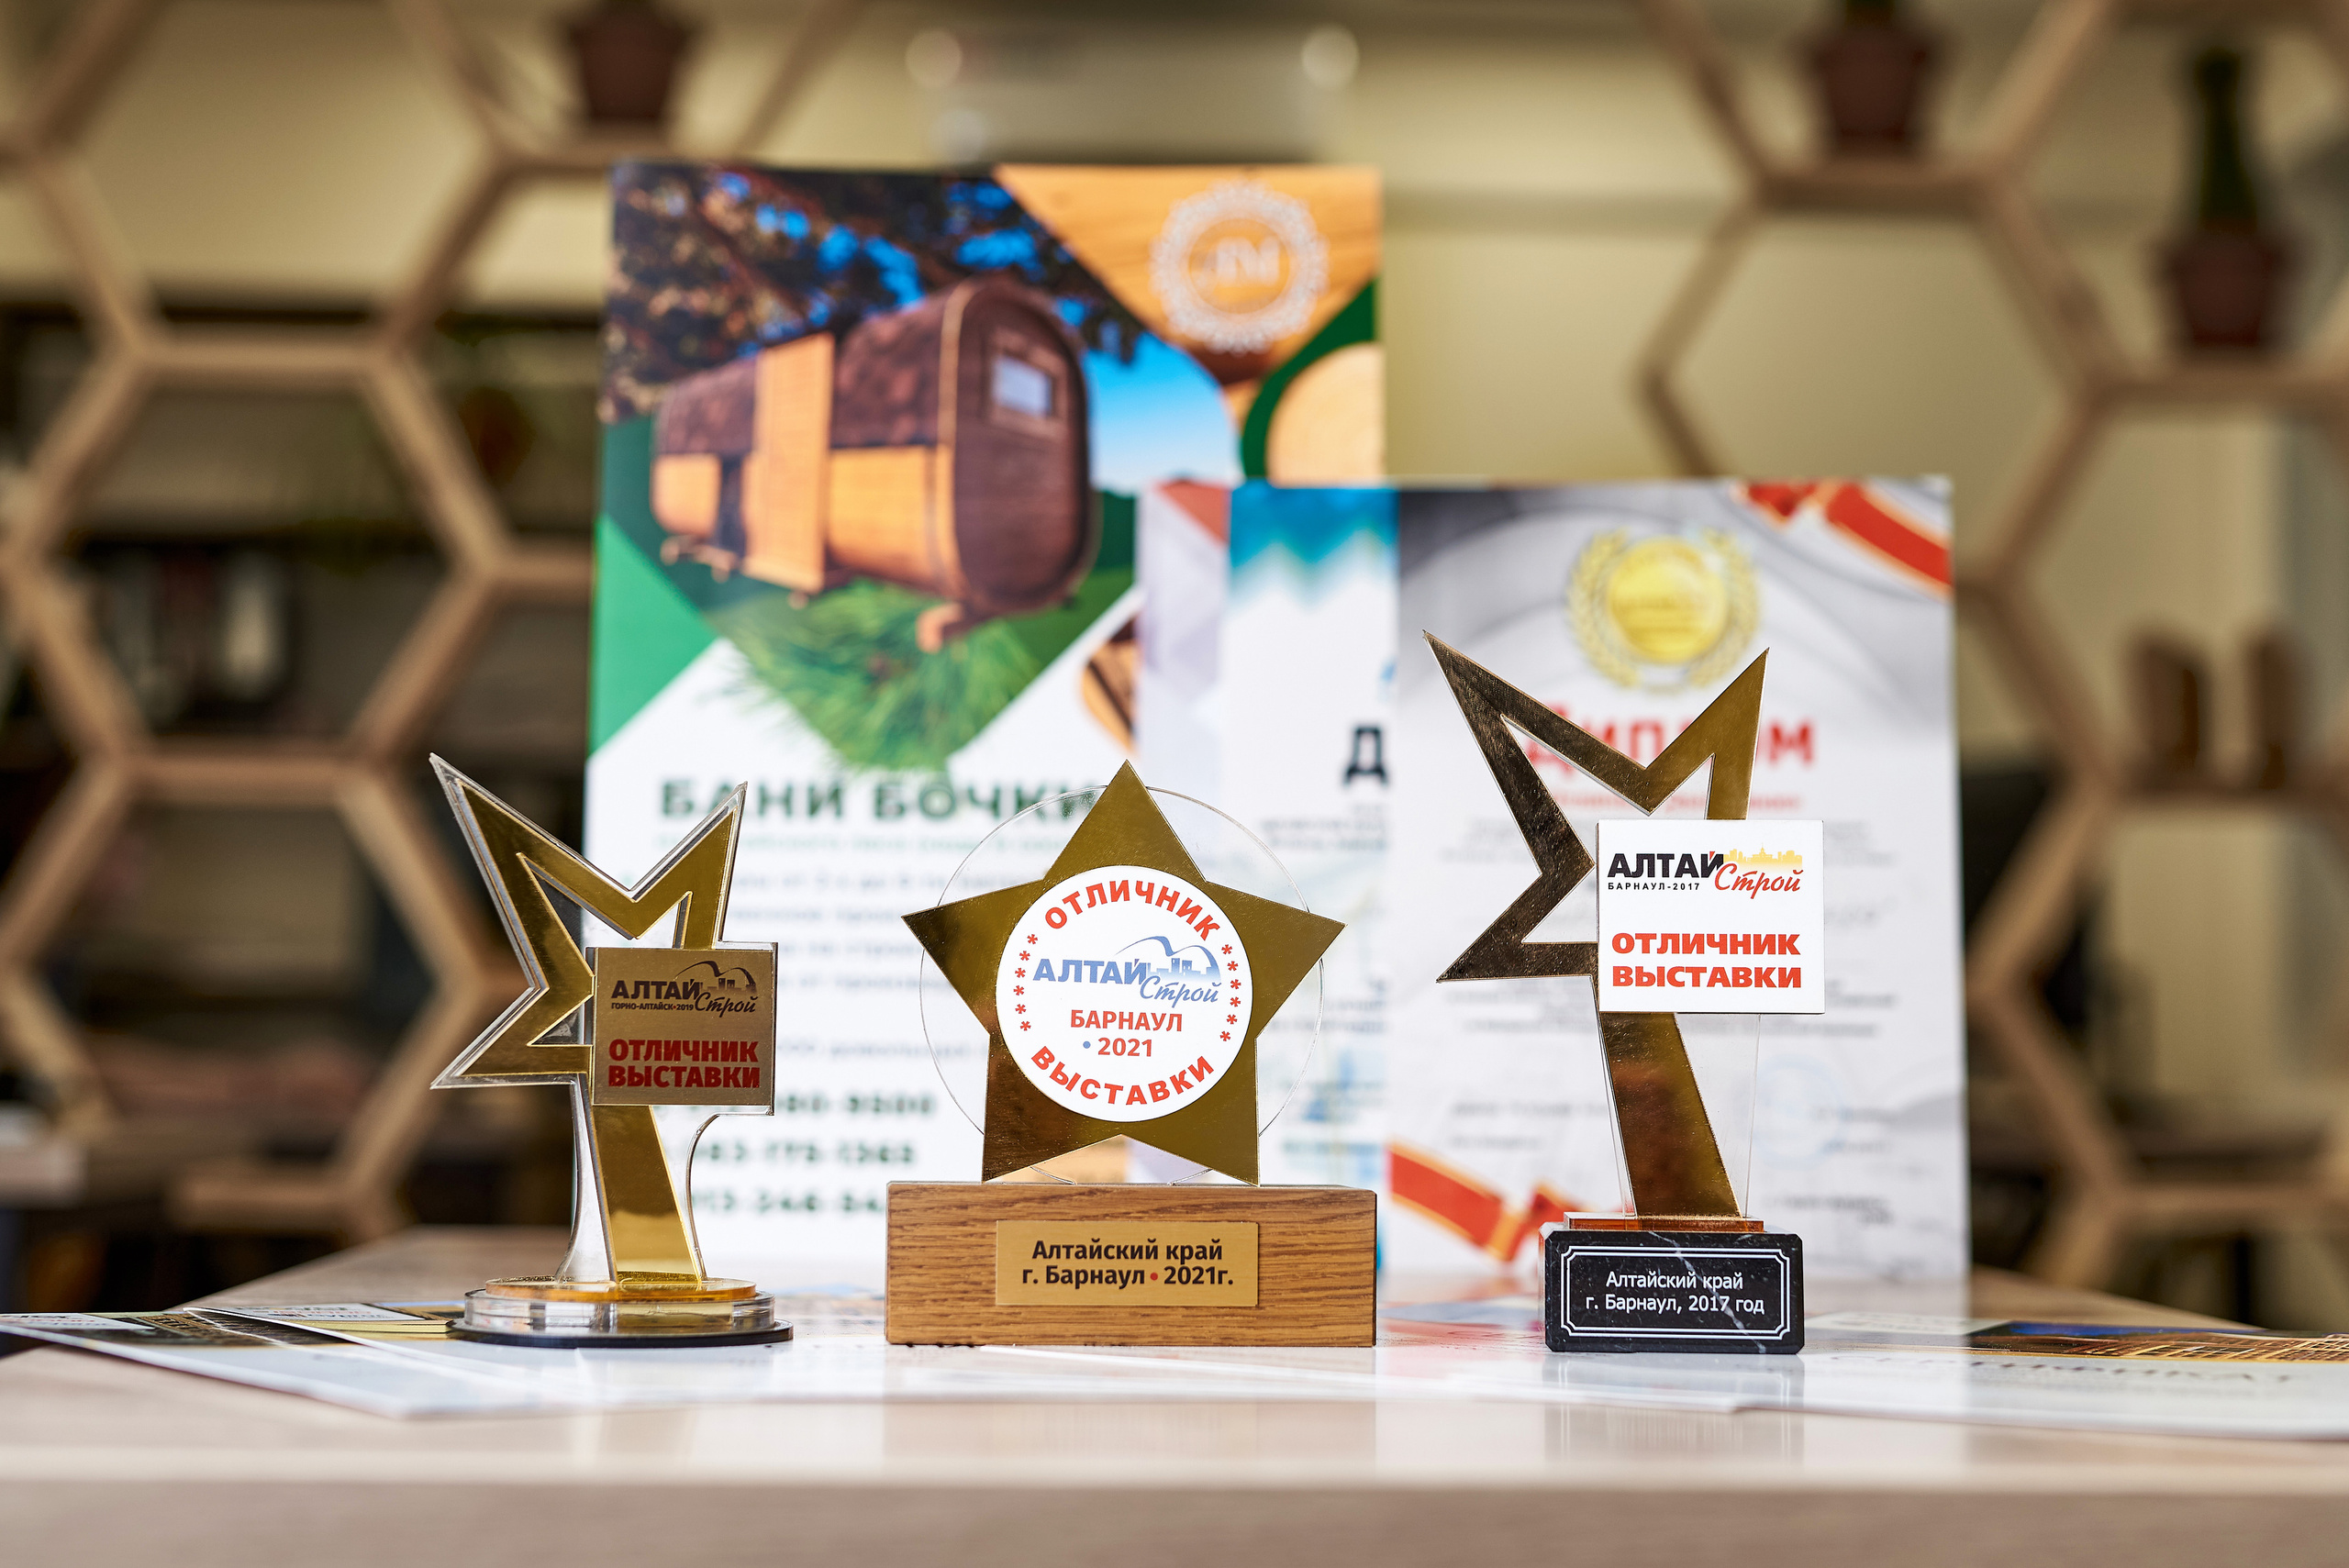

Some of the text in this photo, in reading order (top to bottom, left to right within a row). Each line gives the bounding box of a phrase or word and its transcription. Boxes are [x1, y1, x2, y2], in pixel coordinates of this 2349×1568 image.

[662, 780, 843, 817] БАНИ
[1608, 851, 1804, 899] АЛТАЙ Строй
[1608, 882, 1699, 891] БАРНАУЛ-2017
[1045, 879, 1220, 941] ОТЛИЧНИК
[1611, 932, 1801, 955] ОТЛИЧНИК
[1032, 958, 1222, 1008] АЛТАЙ Строй
[1612, 966, 1801, 989] ВЫСТАВКИ
[611, 979, 759, 1018] АЛТАЙ Строй
[1071, 1009, 1182, 1032] БАРНАУЛ
[609, 1039, 759, 1062] ОТЛИЧНИК
[1097, 1037, 1152, 1057] 2021
[608, 1064, 761, 1089] ВЫСТАВКИ
[1031, 1046, 1214, 1106] ВЫСТАВКИ
[1032, 1238, 1222, 1264] Алтайский край
[1022, 1265, 1234, 1289] г. Барнаул 2021г.
[1606, 1271, 1743, 1291] Алтайский край
[1586, 1295, 1765, 1315] г. Барнаул, 2017 год
